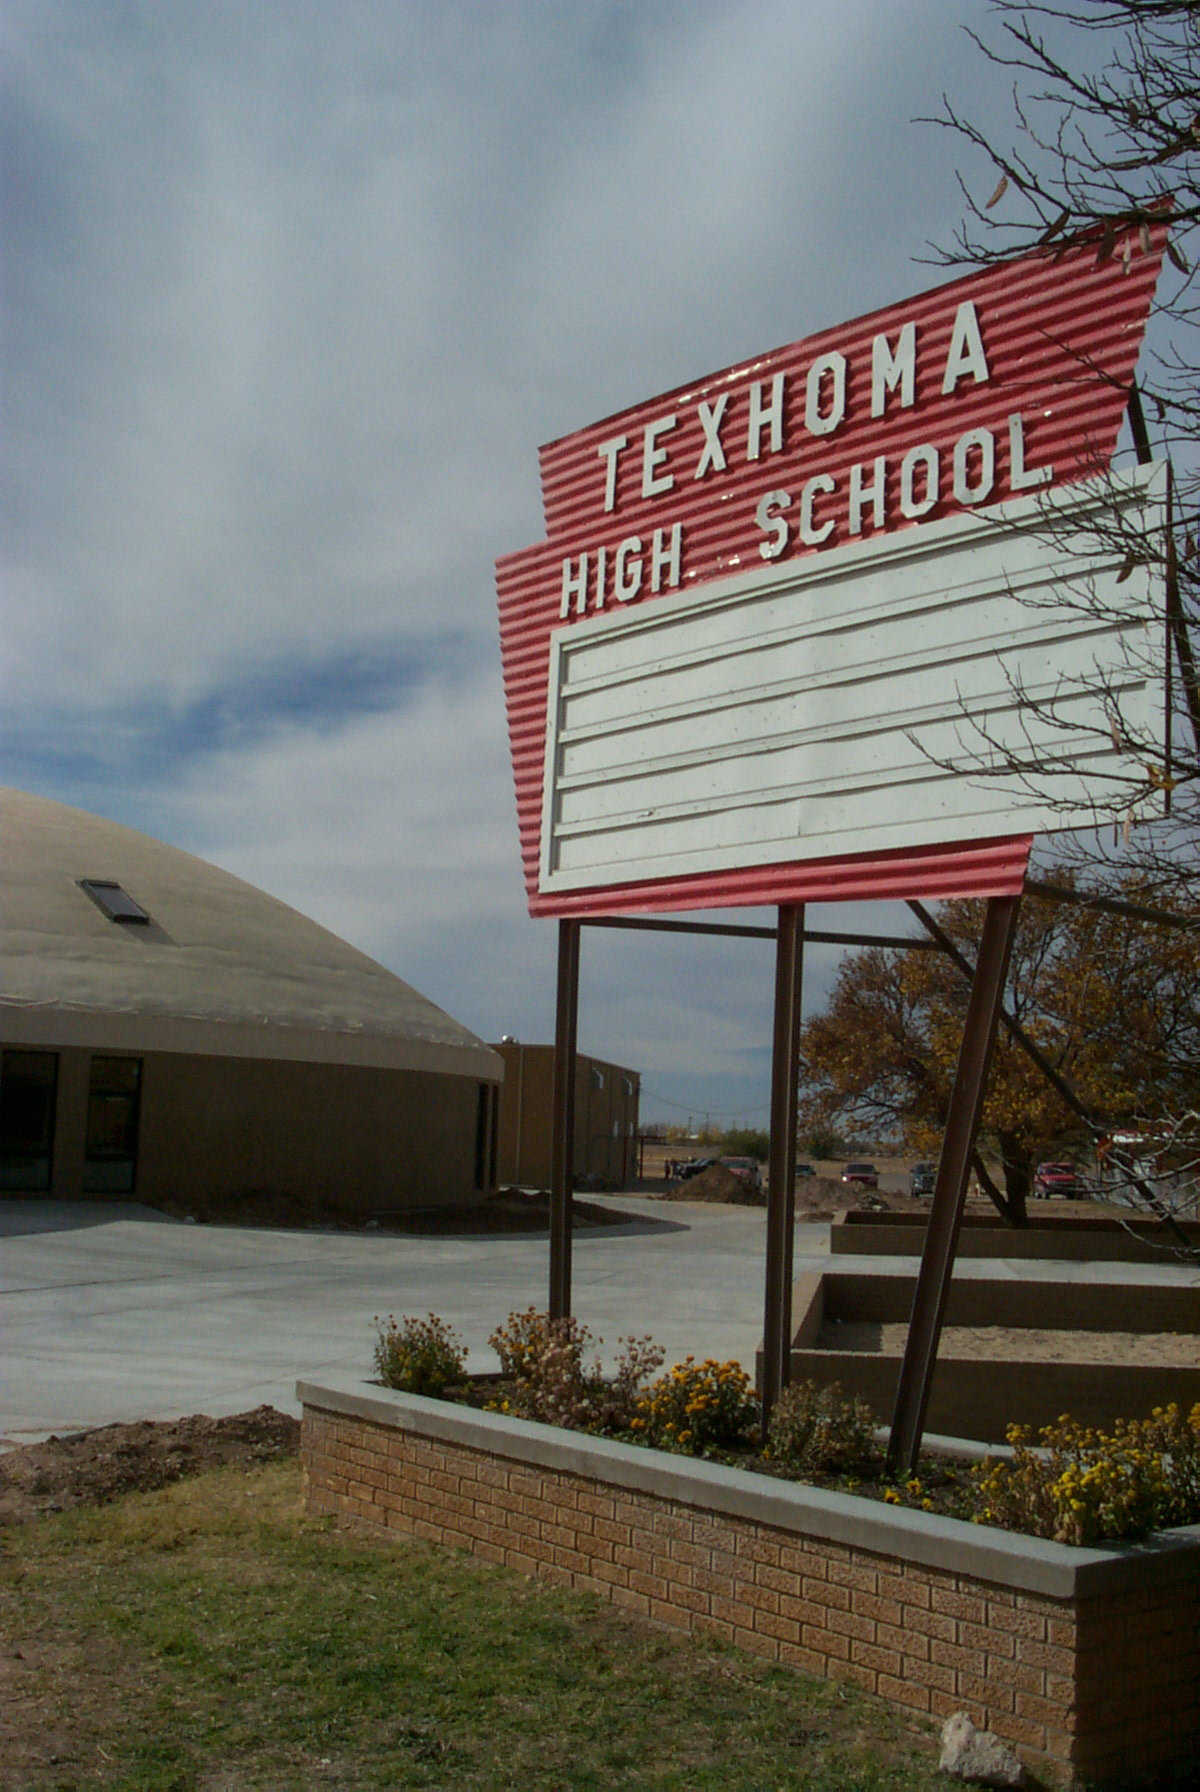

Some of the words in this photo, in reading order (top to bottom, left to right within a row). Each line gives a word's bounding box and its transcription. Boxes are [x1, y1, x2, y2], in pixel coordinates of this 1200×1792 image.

[598, 300, 989, 512] TEXHOMA
[559, 522, 682, 619] HIGH
[754, 412, 1053, 559] SCHOOL
